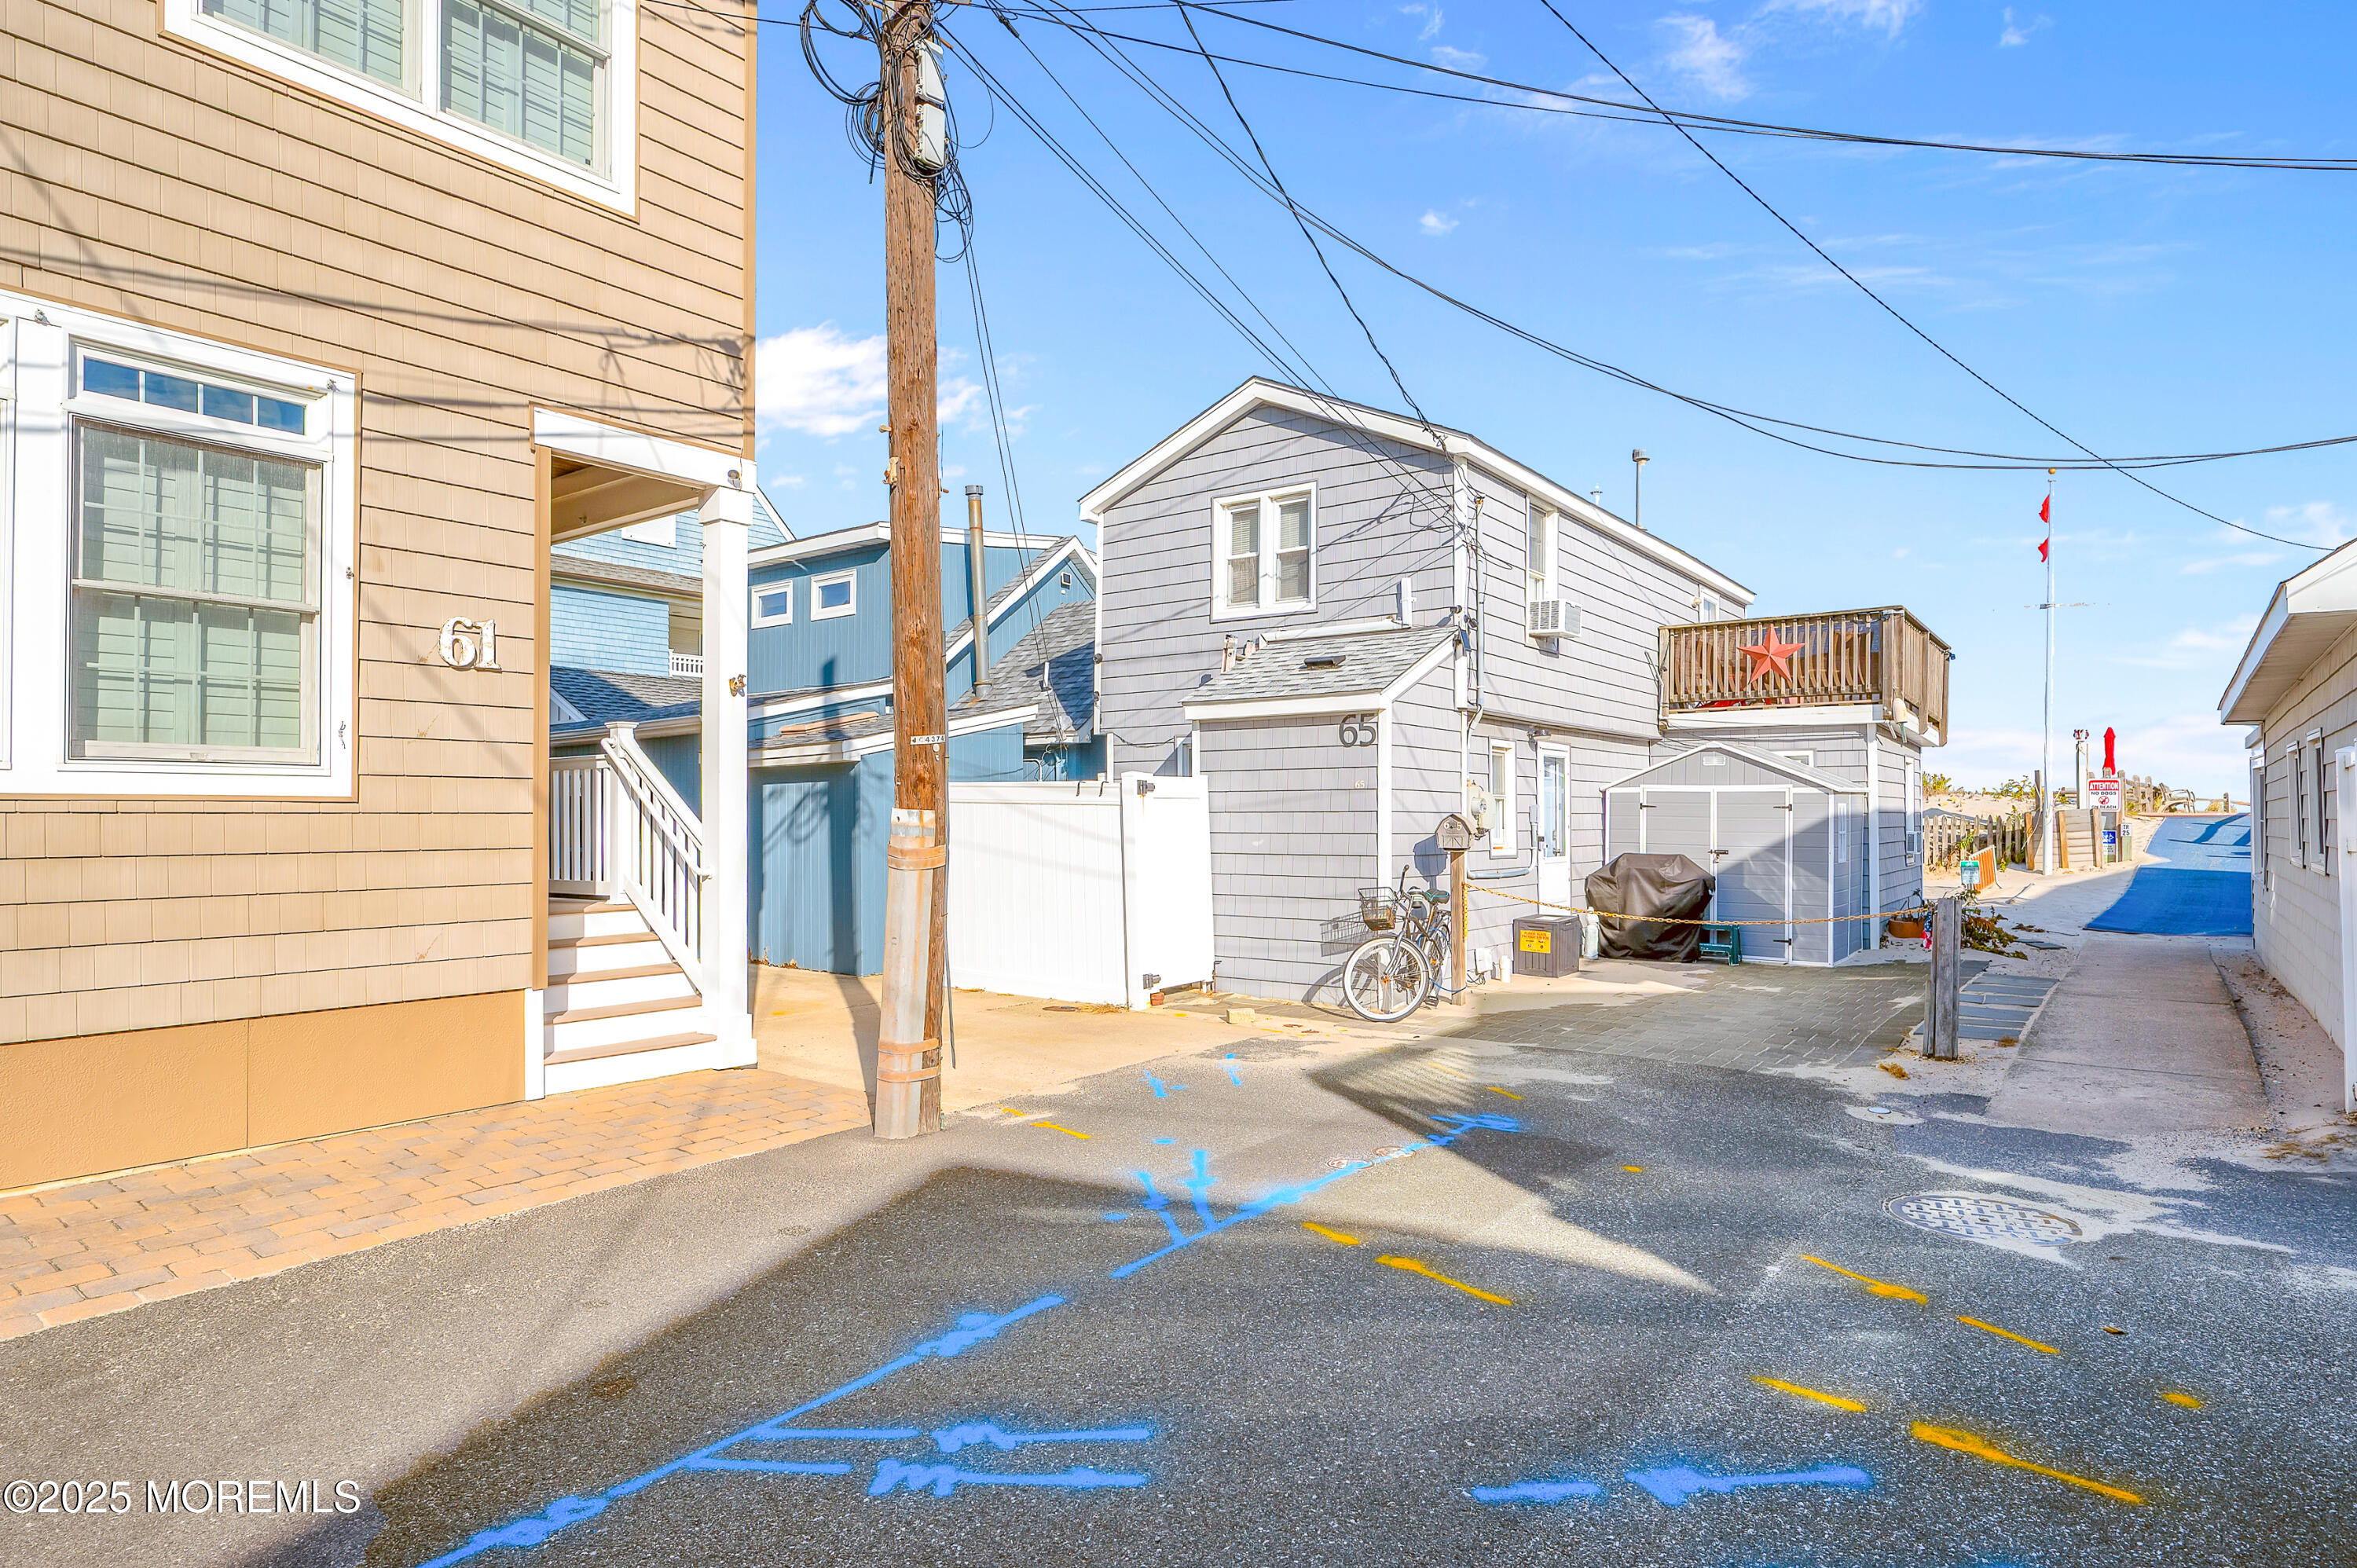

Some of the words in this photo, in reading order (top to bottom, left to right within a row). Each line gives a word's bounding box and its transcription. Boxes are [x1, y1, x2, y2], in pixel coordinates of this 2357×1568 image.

[438, 616, 502, 672] 61
[1339, 713, 1376, 748] 65
[2090, 782, 2119, 790] ATTENTION
